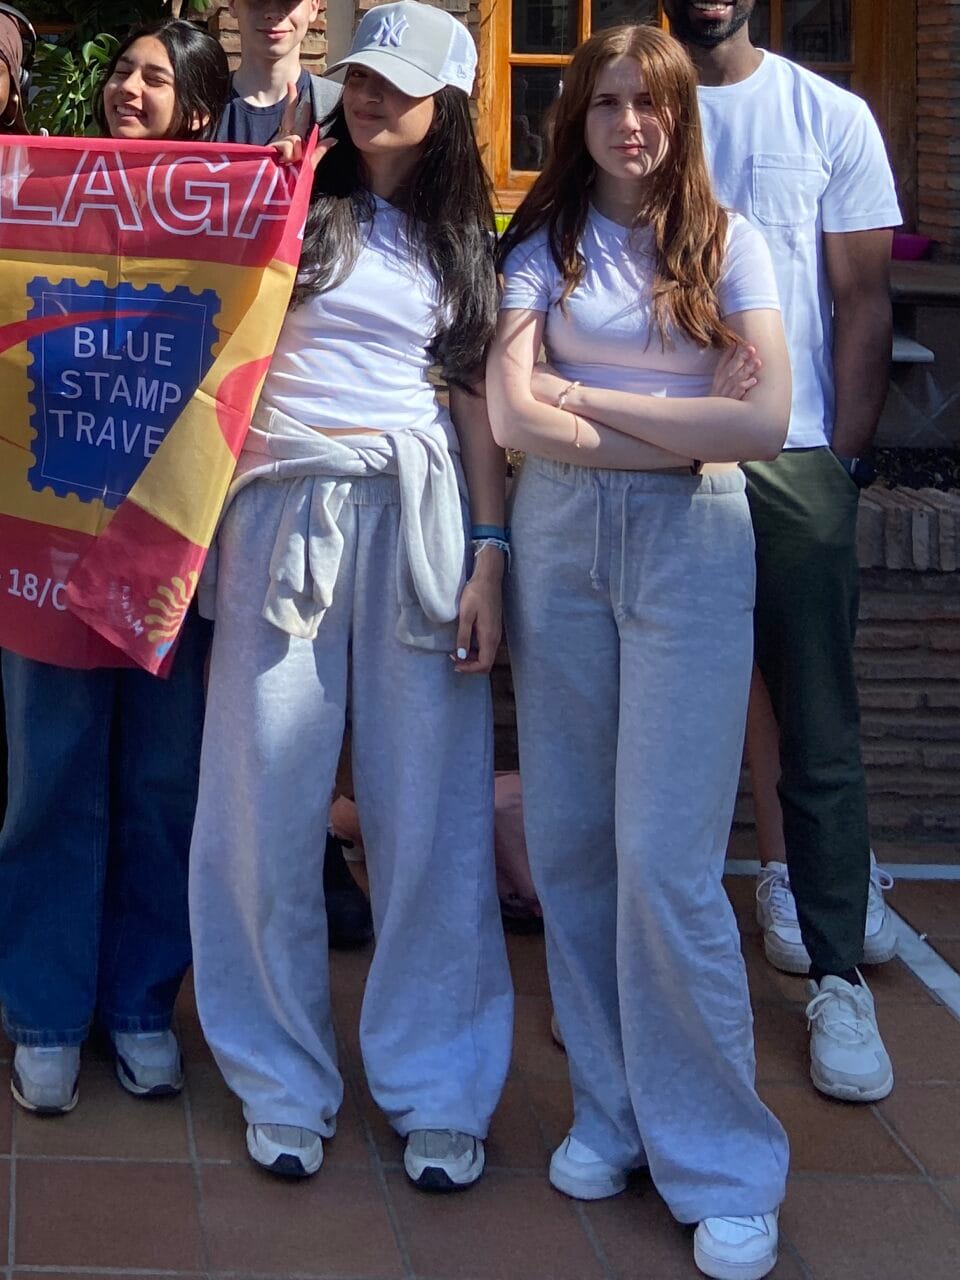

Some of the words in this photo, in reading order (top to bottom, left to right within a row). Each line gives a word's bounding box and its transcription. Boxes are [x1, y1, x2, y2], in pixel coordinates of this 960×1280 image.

[74, 326, 175, 367] BLUE
[60, 369, 182, 414] STAMP
[48, 409, 165, 458] TRAVE
